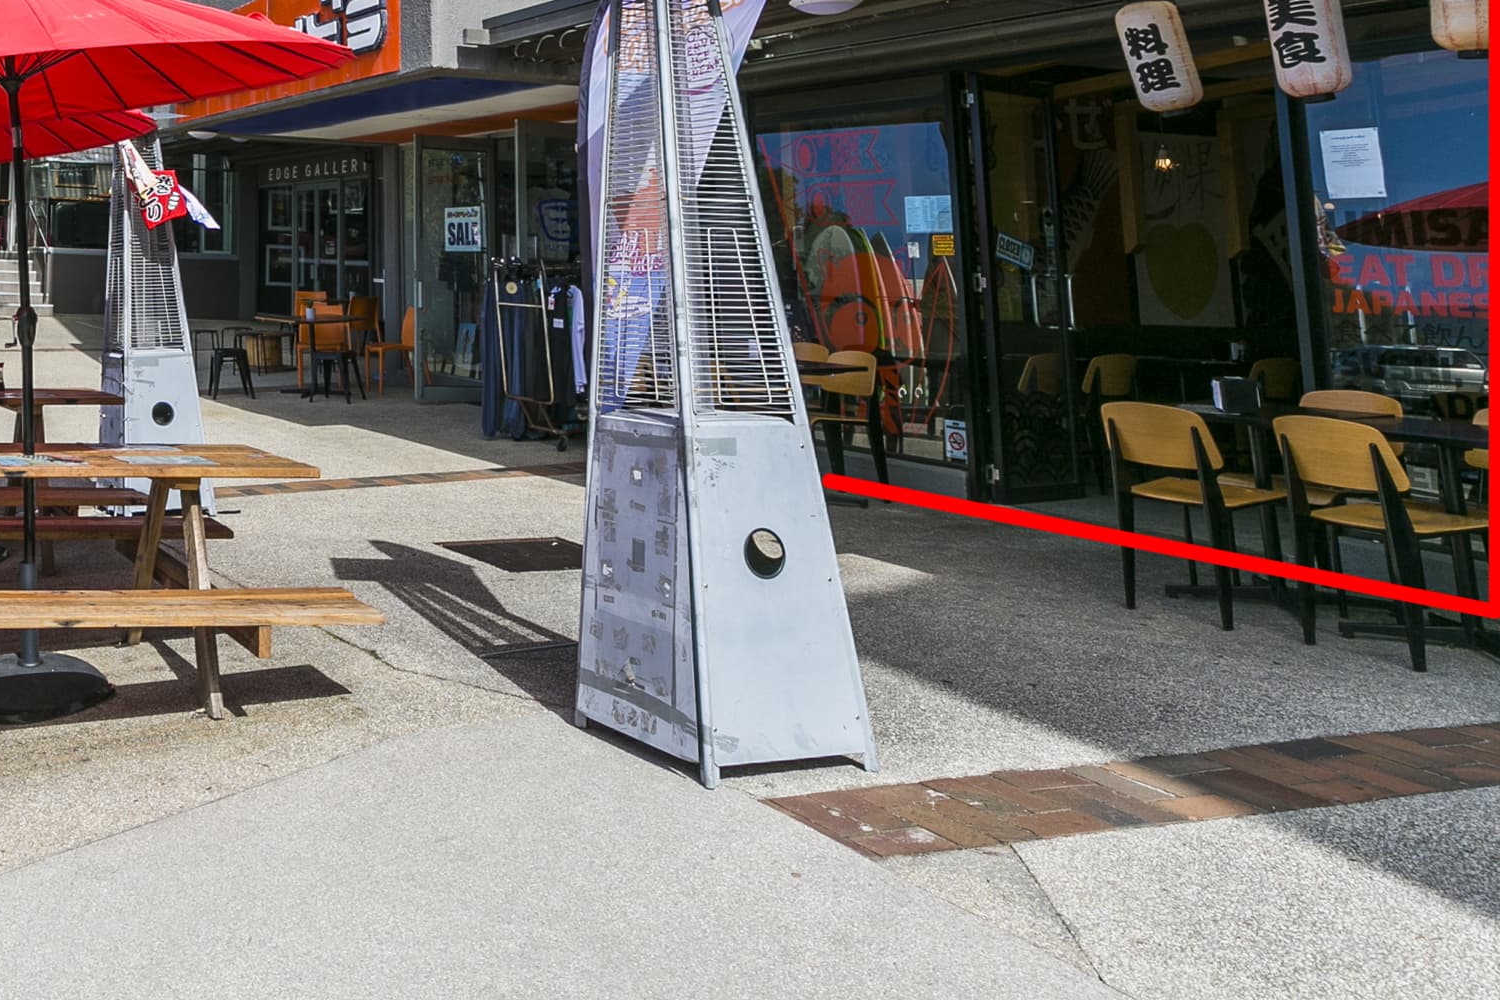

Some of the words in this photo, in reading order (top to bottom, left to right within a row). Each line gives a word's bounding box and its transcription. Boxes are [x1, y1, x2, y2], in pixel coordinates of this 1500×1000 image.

[1125, 23, 1181, 94] 料理
[268, 165, 298, 181] EDGE
[448, 222, 478, 246] SALE
[1330, 254, 1416, 287] EAT
[1335, 322, 1488, 348] 食べて飲ん
